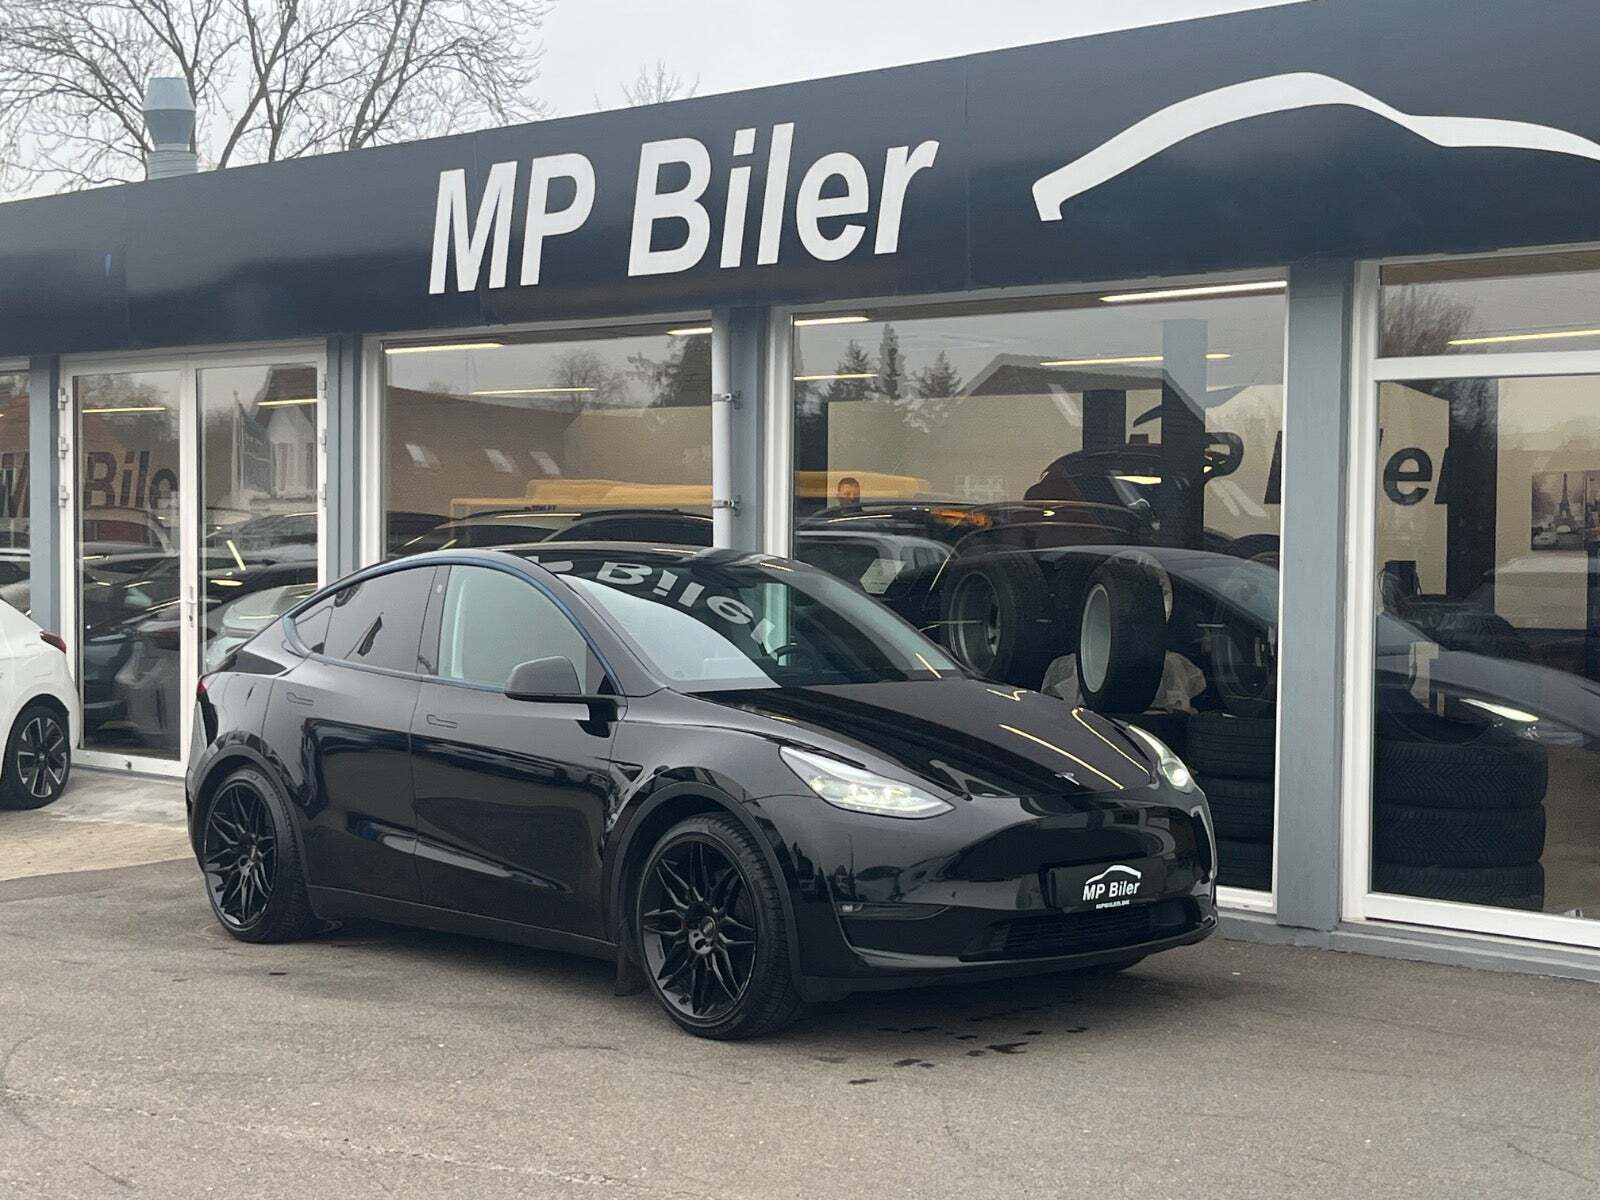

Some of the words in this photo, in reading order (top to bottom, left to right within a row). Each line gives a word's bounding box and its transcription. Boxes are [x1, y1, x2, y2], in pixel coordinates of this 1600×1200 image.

[429, 153, 596, 295] MP
[628, 122, 940, 277] Biler
[83, 450, 178, 509] Bile
[1083, 884, 1105, 901] MP
[1109, 881, 1140, 897] Biler
